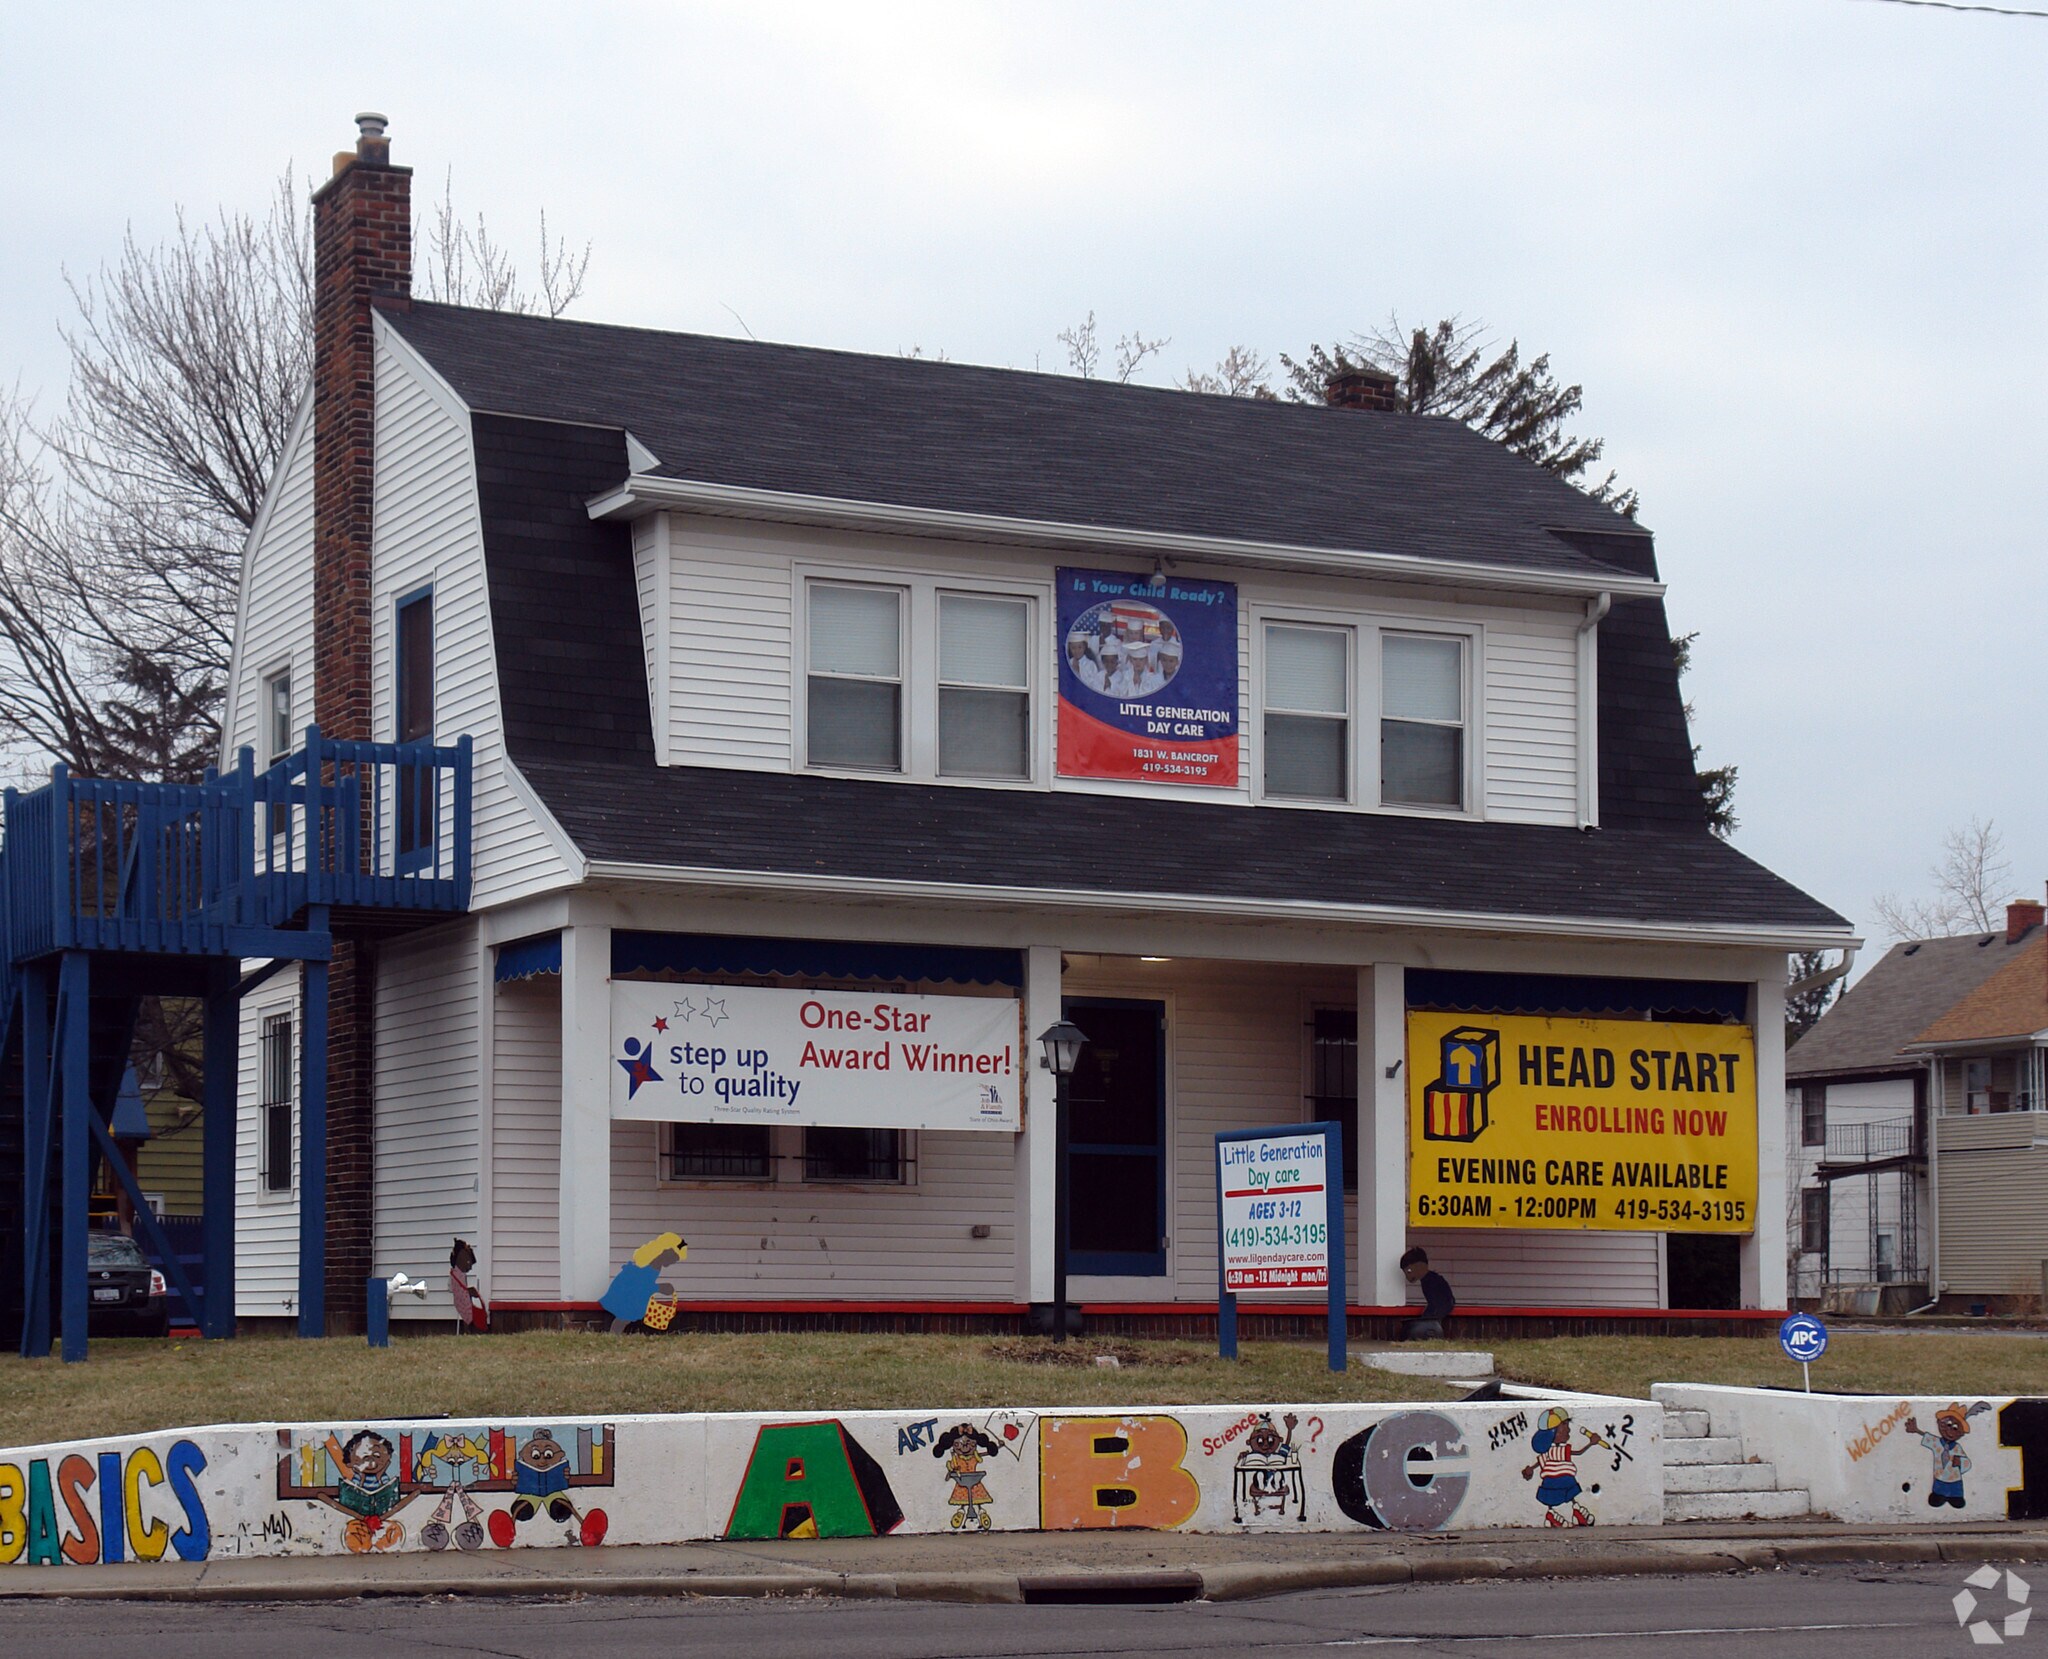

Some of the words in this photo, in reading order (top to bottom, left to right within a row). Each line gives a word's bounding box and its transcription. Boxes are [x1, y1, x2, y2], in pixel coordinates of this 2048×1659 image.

[1073, 578, 1086, 592] Is
[1092, 580, 1124, 595] Your
[1129, 583, 1165, 598] Child
[1170, 587, 1225, 605] Ready?
[1120, 703, 1152, 717] LITTLE
[1155, 706, 1230, 723] GENERATION
[1147, 721, 1170, 735] DAY
[1174, 723, 1204, 737] CARE
[1132, 748, 1154, 759] 1831
[1157, 750, 1168, 760] W.
[1171, 751, 1218, 763] BANCROFT
[1142, 763, 1207, 776] 419-534-3195
[800, 1000, 931, 1033] One-Star
[670, 1041, 726, 1073] step
[737, 1047, 769, 1074] up
[800, 1041, 890, 1071] Award
[901, 1043, 1011, 1075] Winner!
[1519, 1044, 1615, 1088] HEAD
[1630, 1048, 1740, 1093] START
[679, 1072, 704, 1095] to
[714, 1070, 800, 1105] quality
[1535, 1104, 1664, 1135] ENROLLING
[1674, 1109, 1728, 1137] NOW
[1224, 1144, 1255, 1165] Little
[1260, 1140, 1323, 1163] Generation
[1249, 1167, 1270, 1191] Day
[1275, 1168, 1300, 1184] care
[1438, 1157, 1536, 1185] EVENING
[1545, 1160, 1604, 1187] CARE
[1612, 1162, 1728, 1190] AVAILABLE
[1249, 1200, 1277, 1220] AGES
[1279, 1200, 1302, 1218] 3-12
[1418, 1194, 1492, 1218] 6:30AM
[1514, 1197, 1596, 1219] 12:00PM
[1615, 1199, 1746, 1222] 419-534-3195
[1226, 1223, 1326, 1248] (419)-534-3195
[1228, 1251, 1325, 1266] www.lilgendaycare.com
[1269, 1269, 1298, 1286] Midnight
[1790, 1331, 1819, 1345] APC
[898, 1417, 938, 1456] ART
[1202, 1413, 1259, 1456] Science
[1846, 1400, 1912, 1462] Welcome
[723, 1418, 903, 1539] A
[1039, 1414, 1200, 1531] B
[1333, 1410, 1471, 1531] C
[0, 1440, 211, 1565] BASICS
